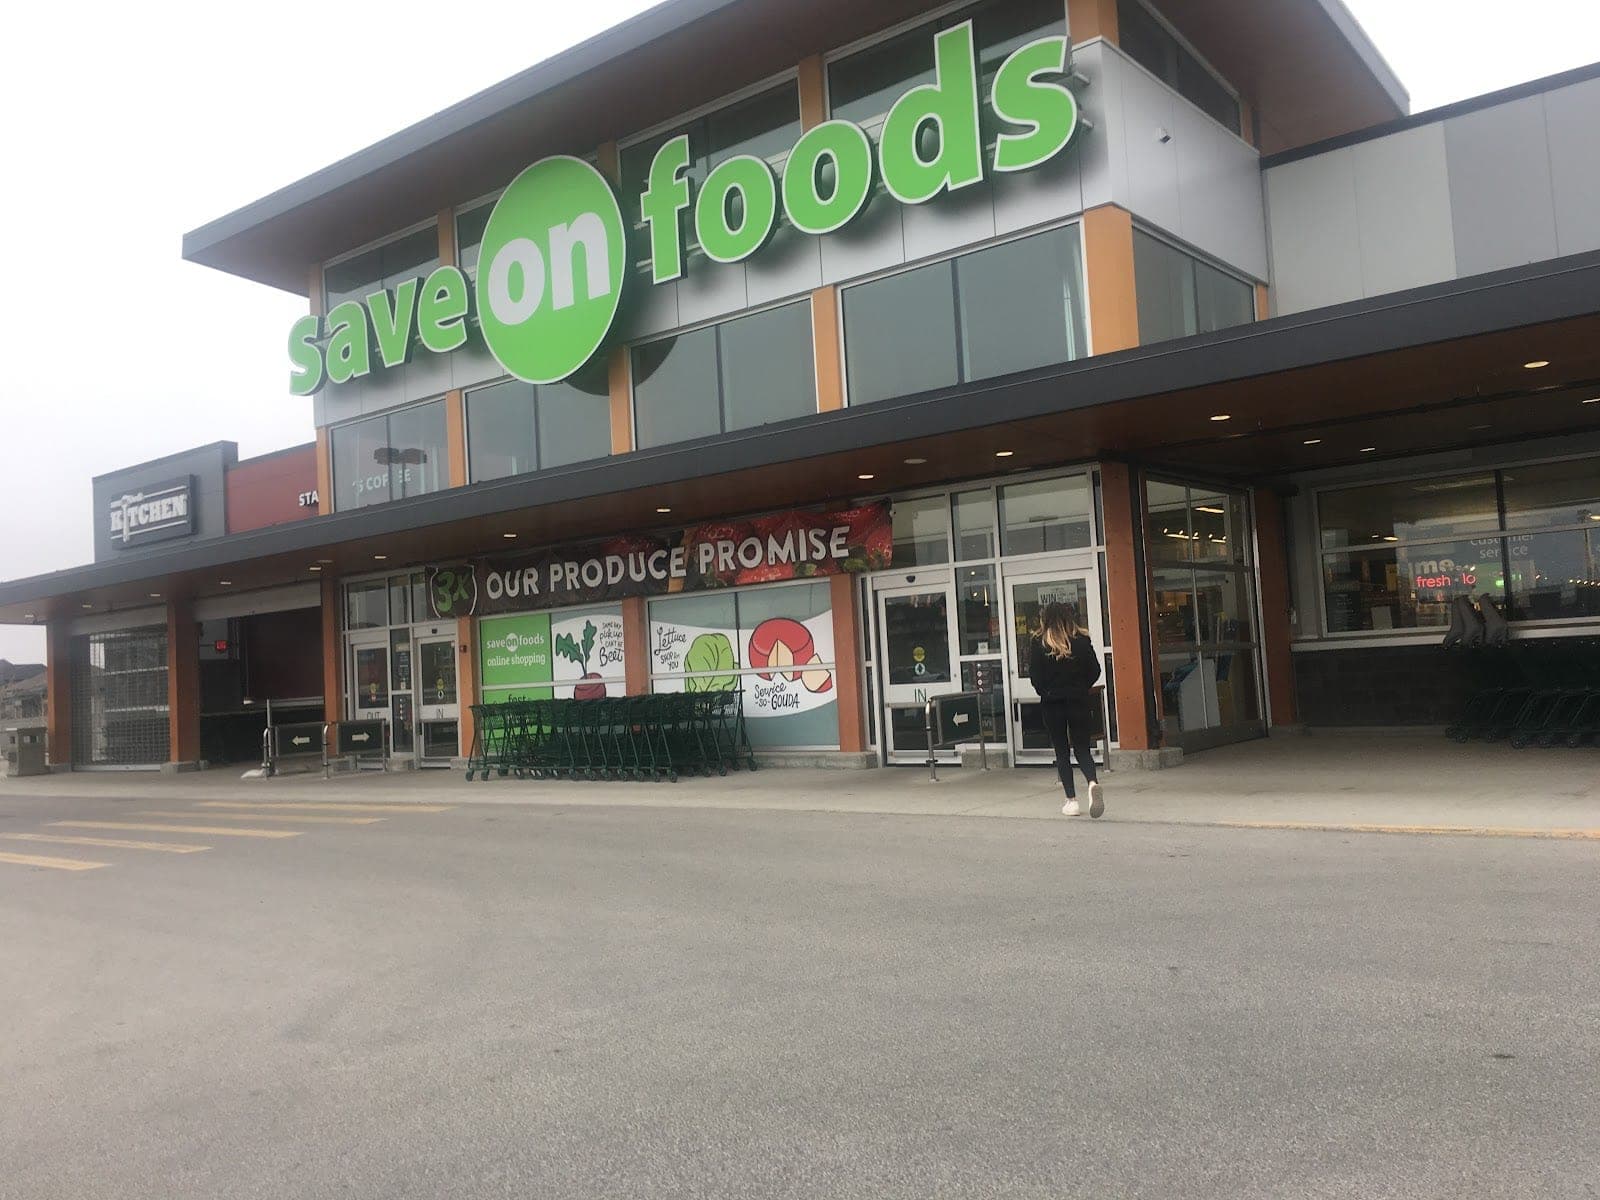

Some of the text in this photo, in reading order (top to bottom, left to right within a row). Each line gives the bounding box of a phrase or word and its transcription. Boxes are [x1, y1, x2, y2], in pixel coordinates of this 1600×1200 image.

[288, 18, 1078, 396] save on foods
[486, 567, 539, 600] OUR
[549, 546, 687, 593] PRODUCE
[697, 526, 851, 574] PROMISE
[1416, 575, 1451, 588] fresh
[486, 639, 506, 649] save
[519, 633, 545, 646] foods
[654, 626, 687, 656] Lettuce
[487, 653, 546, 667] online shopping
[600, 646, 624, 667] Beet
[755, 682, 787, 699] Service
[914, 688, 926, 703] IN
[771, 693, 800, 710] GOUDA
